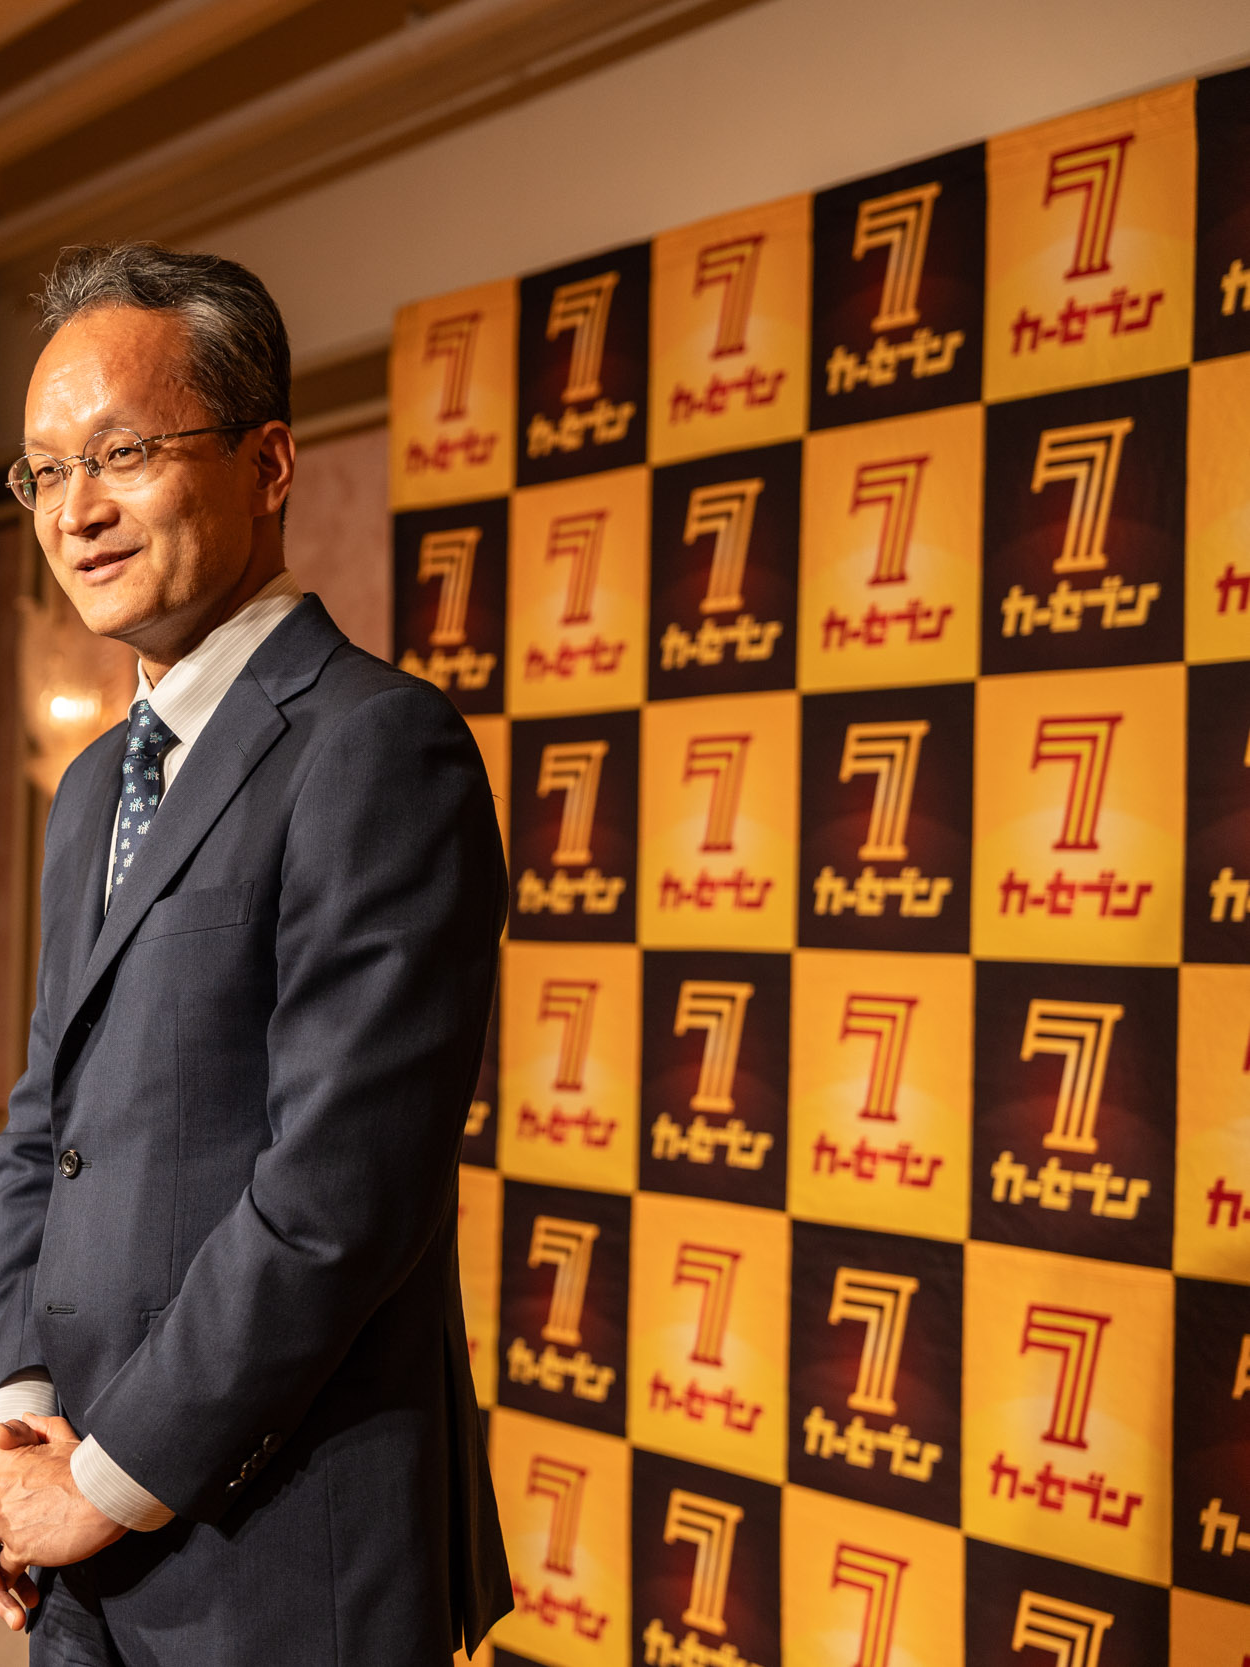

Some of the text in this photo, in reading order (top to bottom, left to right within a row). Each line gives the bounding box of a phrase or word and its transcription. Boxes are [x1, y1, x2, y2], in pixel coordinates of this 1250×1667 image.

[1011, 287, 1165, 356] カーセブン
[827, 331, 963, 392] カーセブン
[669, 366, 788, 424] カーセブン
[821, 602, 954, 650] カーセブン
[1002, 577, 1160, 636] カーセブン
[661, 617, 781, 667] カーセブン
[659, 869, 773, 911] カーセブン
[815, 867, 951, 916] カーセブン
[999, 870, 1153, 919] カーセブン
[653, 1112, 772, 1169] カーセブン
[812, 1132, 943, 1190] カーセブン
[991, 1153, 1150, 1219] カーセブン
[648, 1371, 764, 1435] カーセブン
[805, 1407, 941, 1482] カーセブン
[990, 1452, 1144, 1530] カーセブン
